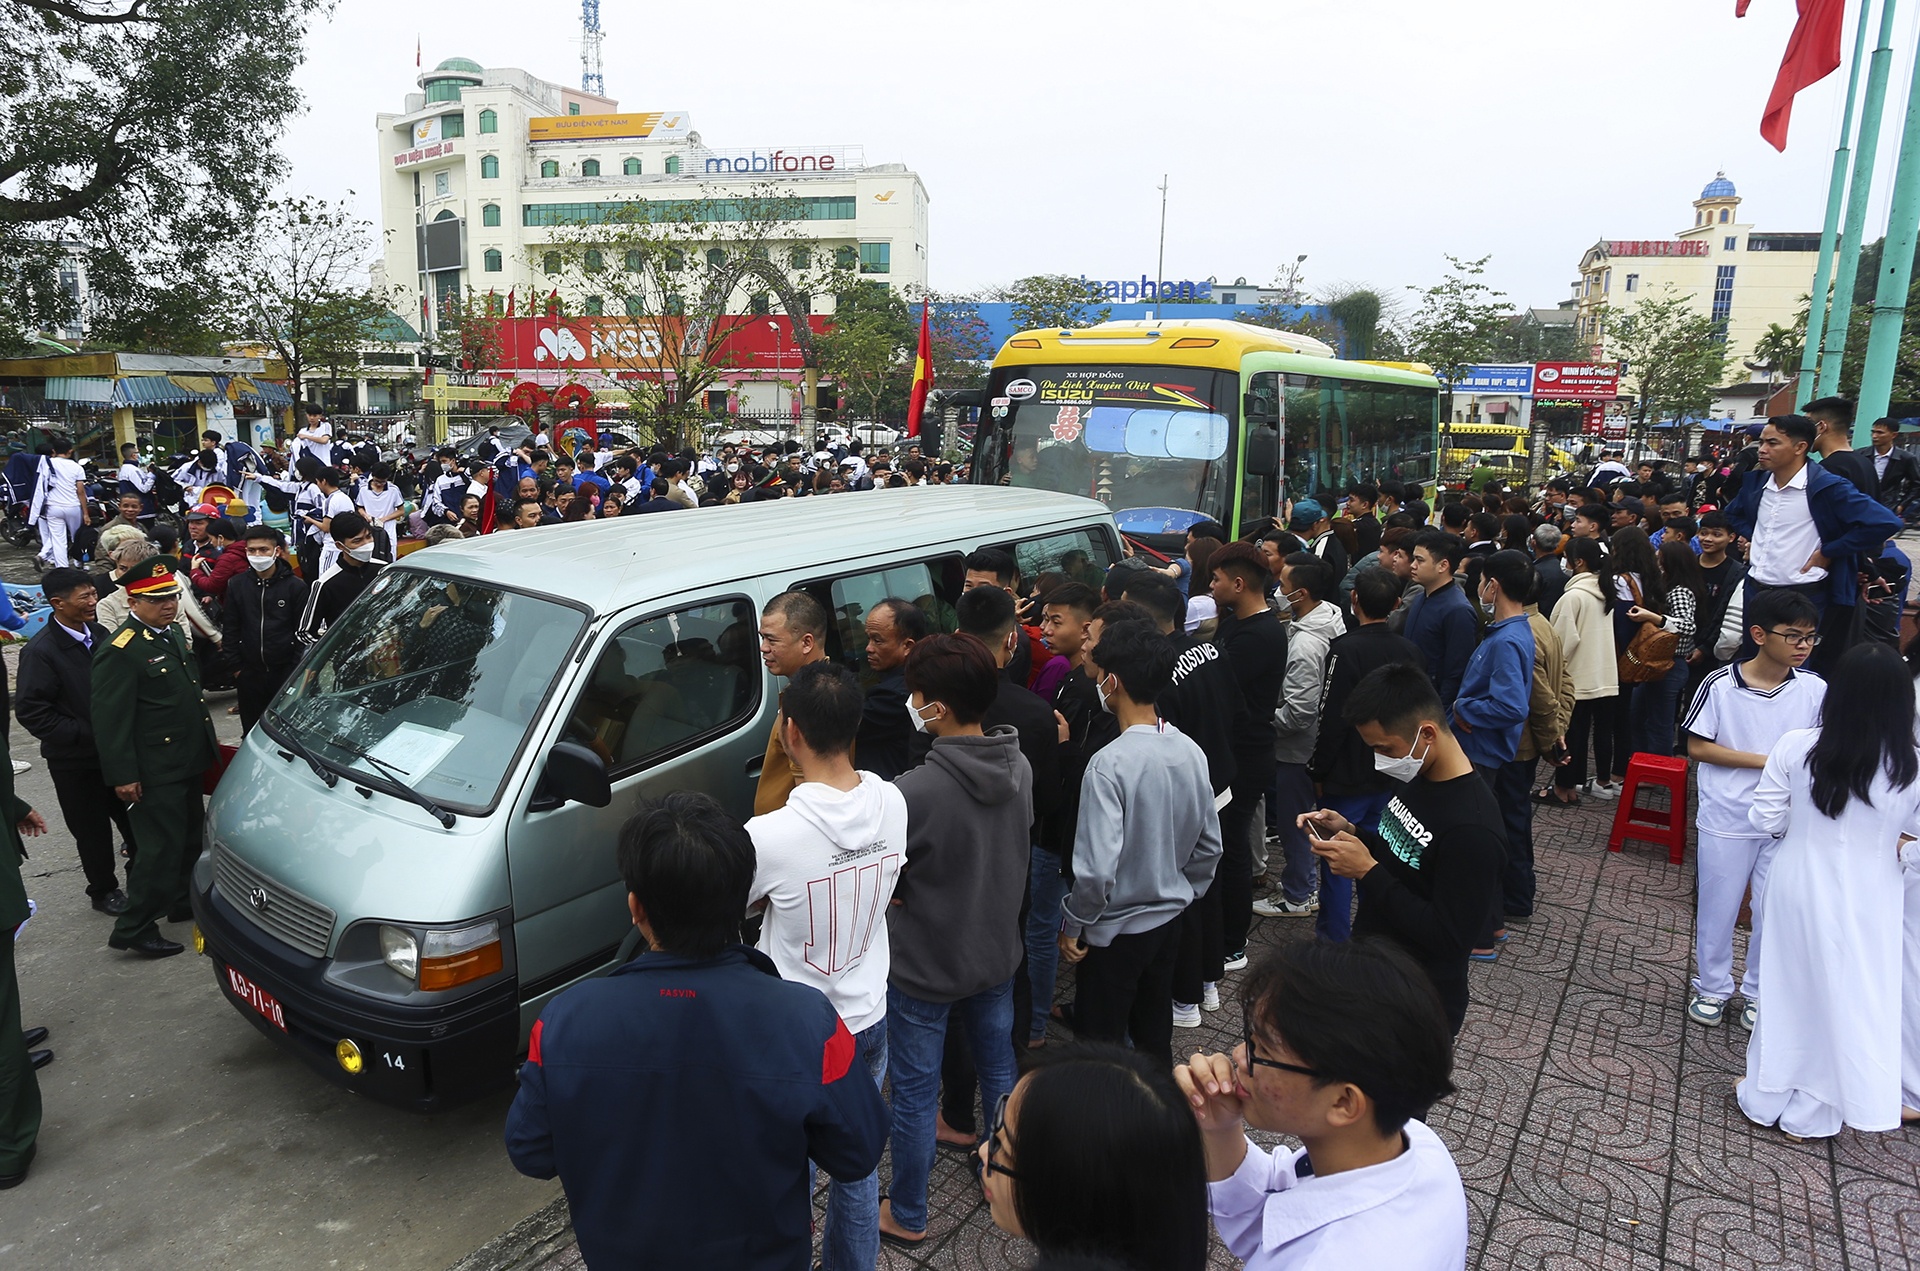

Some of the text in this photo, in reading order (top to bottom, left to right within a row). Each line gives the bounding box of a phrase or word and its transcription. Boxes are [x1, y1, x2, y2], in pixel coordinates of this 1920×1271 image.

[556, 121, 571, 129] BƯU
[573, 120, 592, 129] ĐIỆN
[593, 119, 608, 128] VIỆT
[444, 142, 454, 154] AN
[705, 150, 835, 173] mobifone
[1671, 239, 1709, 256] HOTEL
[591, 330, 662, 358] MSB
[1080, 371, 1098, 380] HỢP
[1561, 366, 1579, 376] MINH
[1041, 390, 1094, 400] ISUZU
[1102, 391, 1149, 399] WELCOME
[659, 988, 696, 999] FASVIN
[383, 1052, 405, 1070] 14
